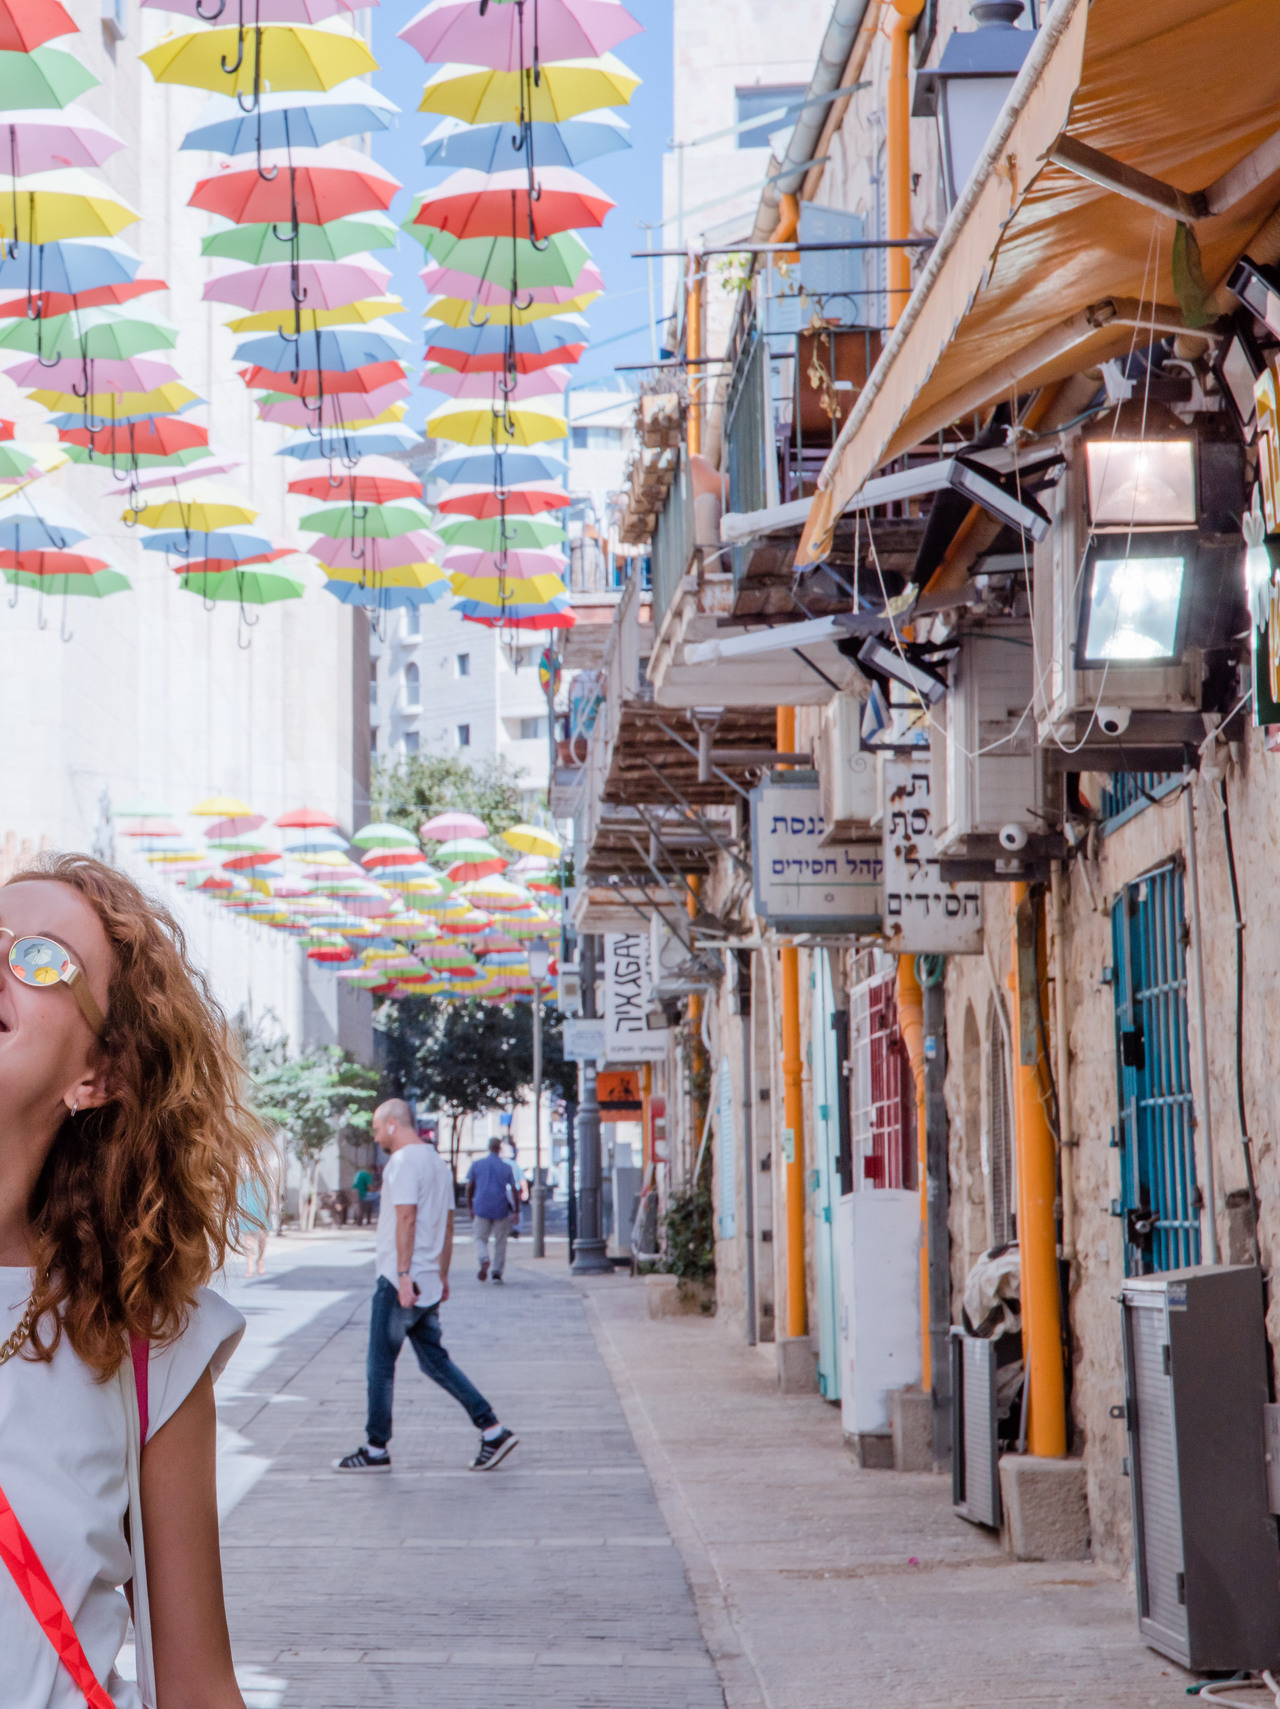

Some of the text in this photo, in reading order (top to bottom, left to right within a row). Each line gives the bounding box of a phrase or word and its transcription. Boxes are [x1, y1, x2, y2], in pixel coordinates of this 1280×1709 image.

[770, 815, 824, 835] נסת
[772, 849, 884, 880] קהל חסידים
[888, 893, 979, 916] חסידים
